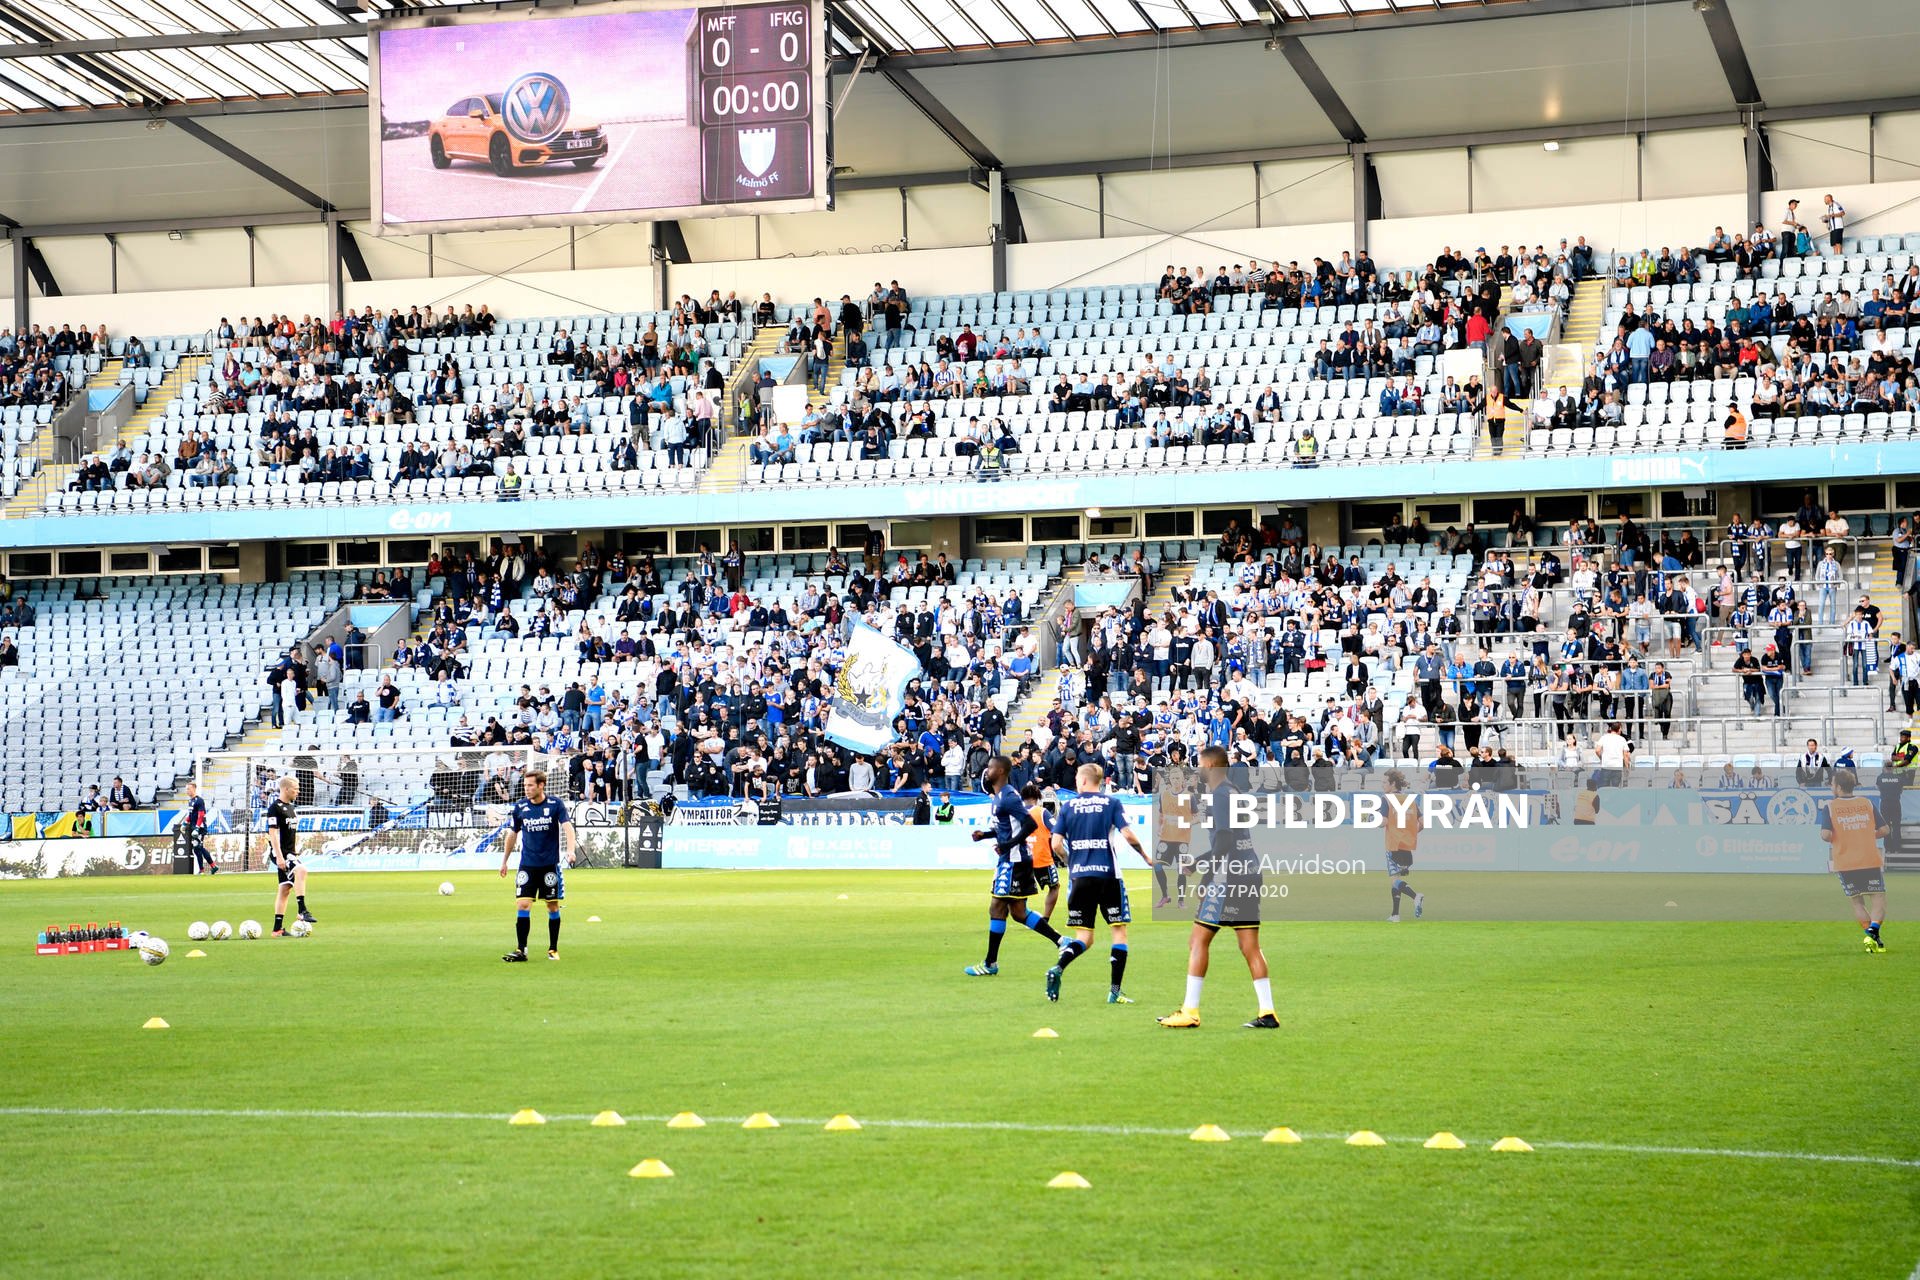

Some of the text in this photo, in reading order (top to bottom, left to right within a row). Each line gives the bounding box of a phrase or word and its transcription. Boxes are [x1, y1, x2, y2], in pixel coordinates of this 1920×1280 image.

[707, 11, 804, 32] MFF IFKG
[712, 37, 730, 67] 0
[780, 32, 799, 62] 0
[712, 81, 799, 115] 00:00
[736, 171, 779, 187] Malmö FF
